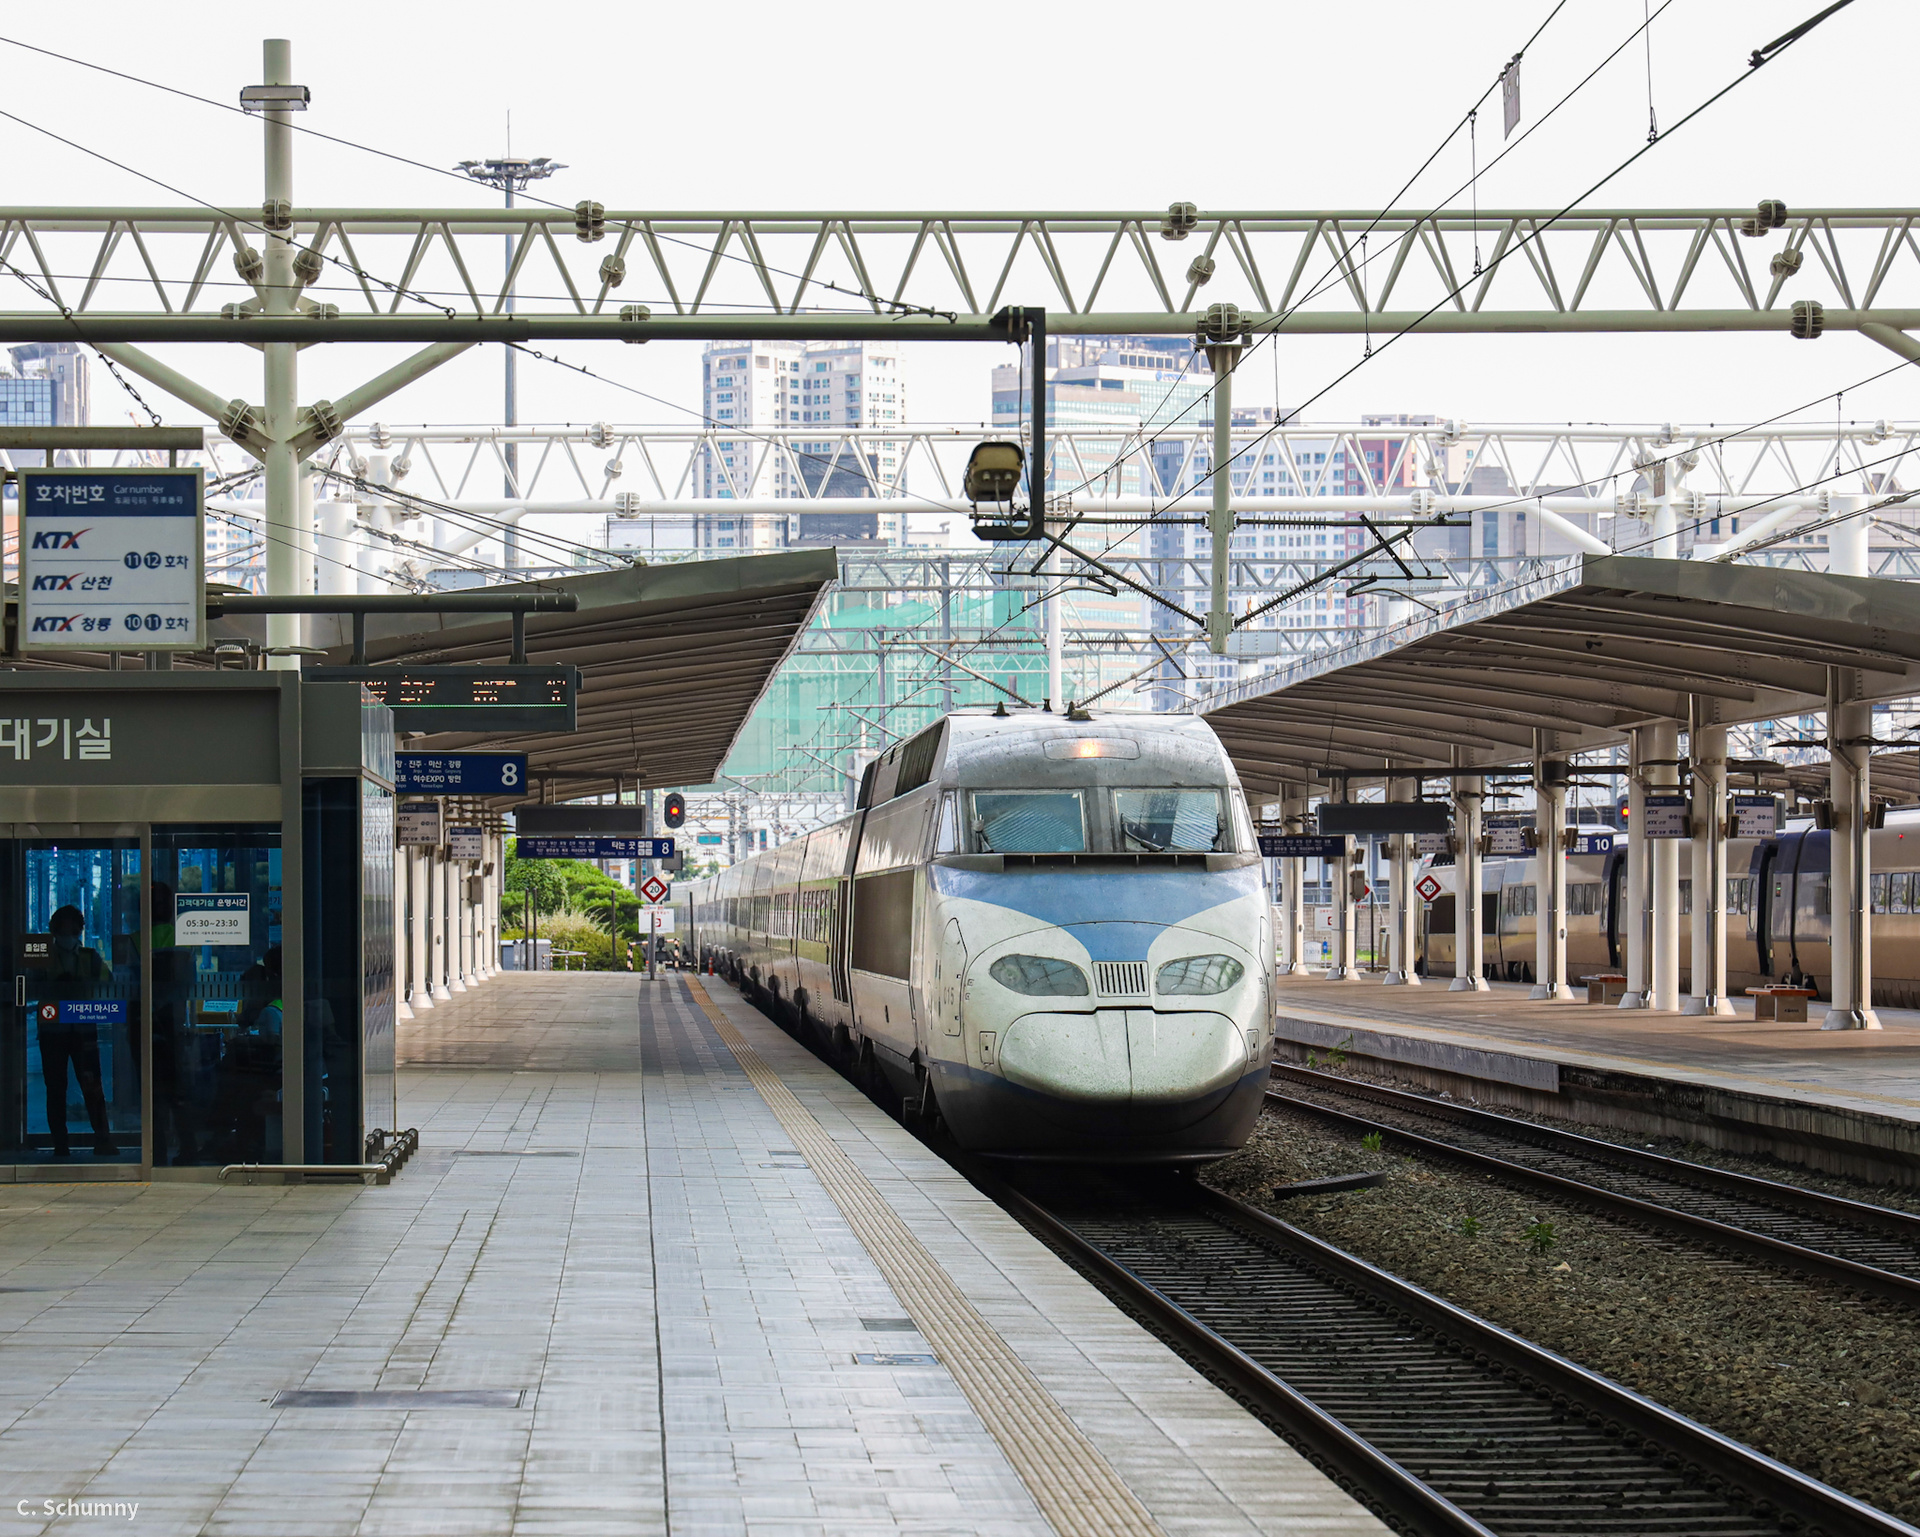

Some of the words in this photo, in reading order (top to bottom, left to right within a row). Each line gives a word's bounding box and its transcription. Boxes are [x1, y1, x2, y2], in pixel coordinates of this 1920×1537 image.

[1153, 442, 1183, 454] UMINI
[36, 485, 105, 504] 호차번호
[113, 484, 128, 494] Car
[129, 484, 164, 494] number
[32, 528, 94, 549] KTX
[125, 553, 140, 567] 11
[145, 553, 160, 567] 12
[164, 555, 188, 569] 호차
[32, 572, 84, 590] KTX
[81, 576, 112, 590] 산천
[32, 613, 84, 631] KTX
[81, 617, 111, 631] 청룡
[126, 615, 141, 629] 10
[145, 615, 160, 629] 11
[165, 617, 189, 631] 호차
[0, 718, 111, 760] 대기실
[501, 763, 518, 786] 8
[611, 841, 625, 850] 타는
[629, 841, 635, 850] 곳
[661, 842, 669, 854] 8
[1594, 838, 1609, 851] 10
[650, 885, 660, 893] 20
[1424, 884, 1434, 892] 20
[178, 898, 214, 907] 고객대기실
[217, 898, 246, 907] 운영시간
[186, 919, 238, 927] 05:30~23:30
[25, 943, 47, 952] 출입문
[67, 1004, 91, 1013] 기대지
[94, 1004, 119, 1013] 마시오
